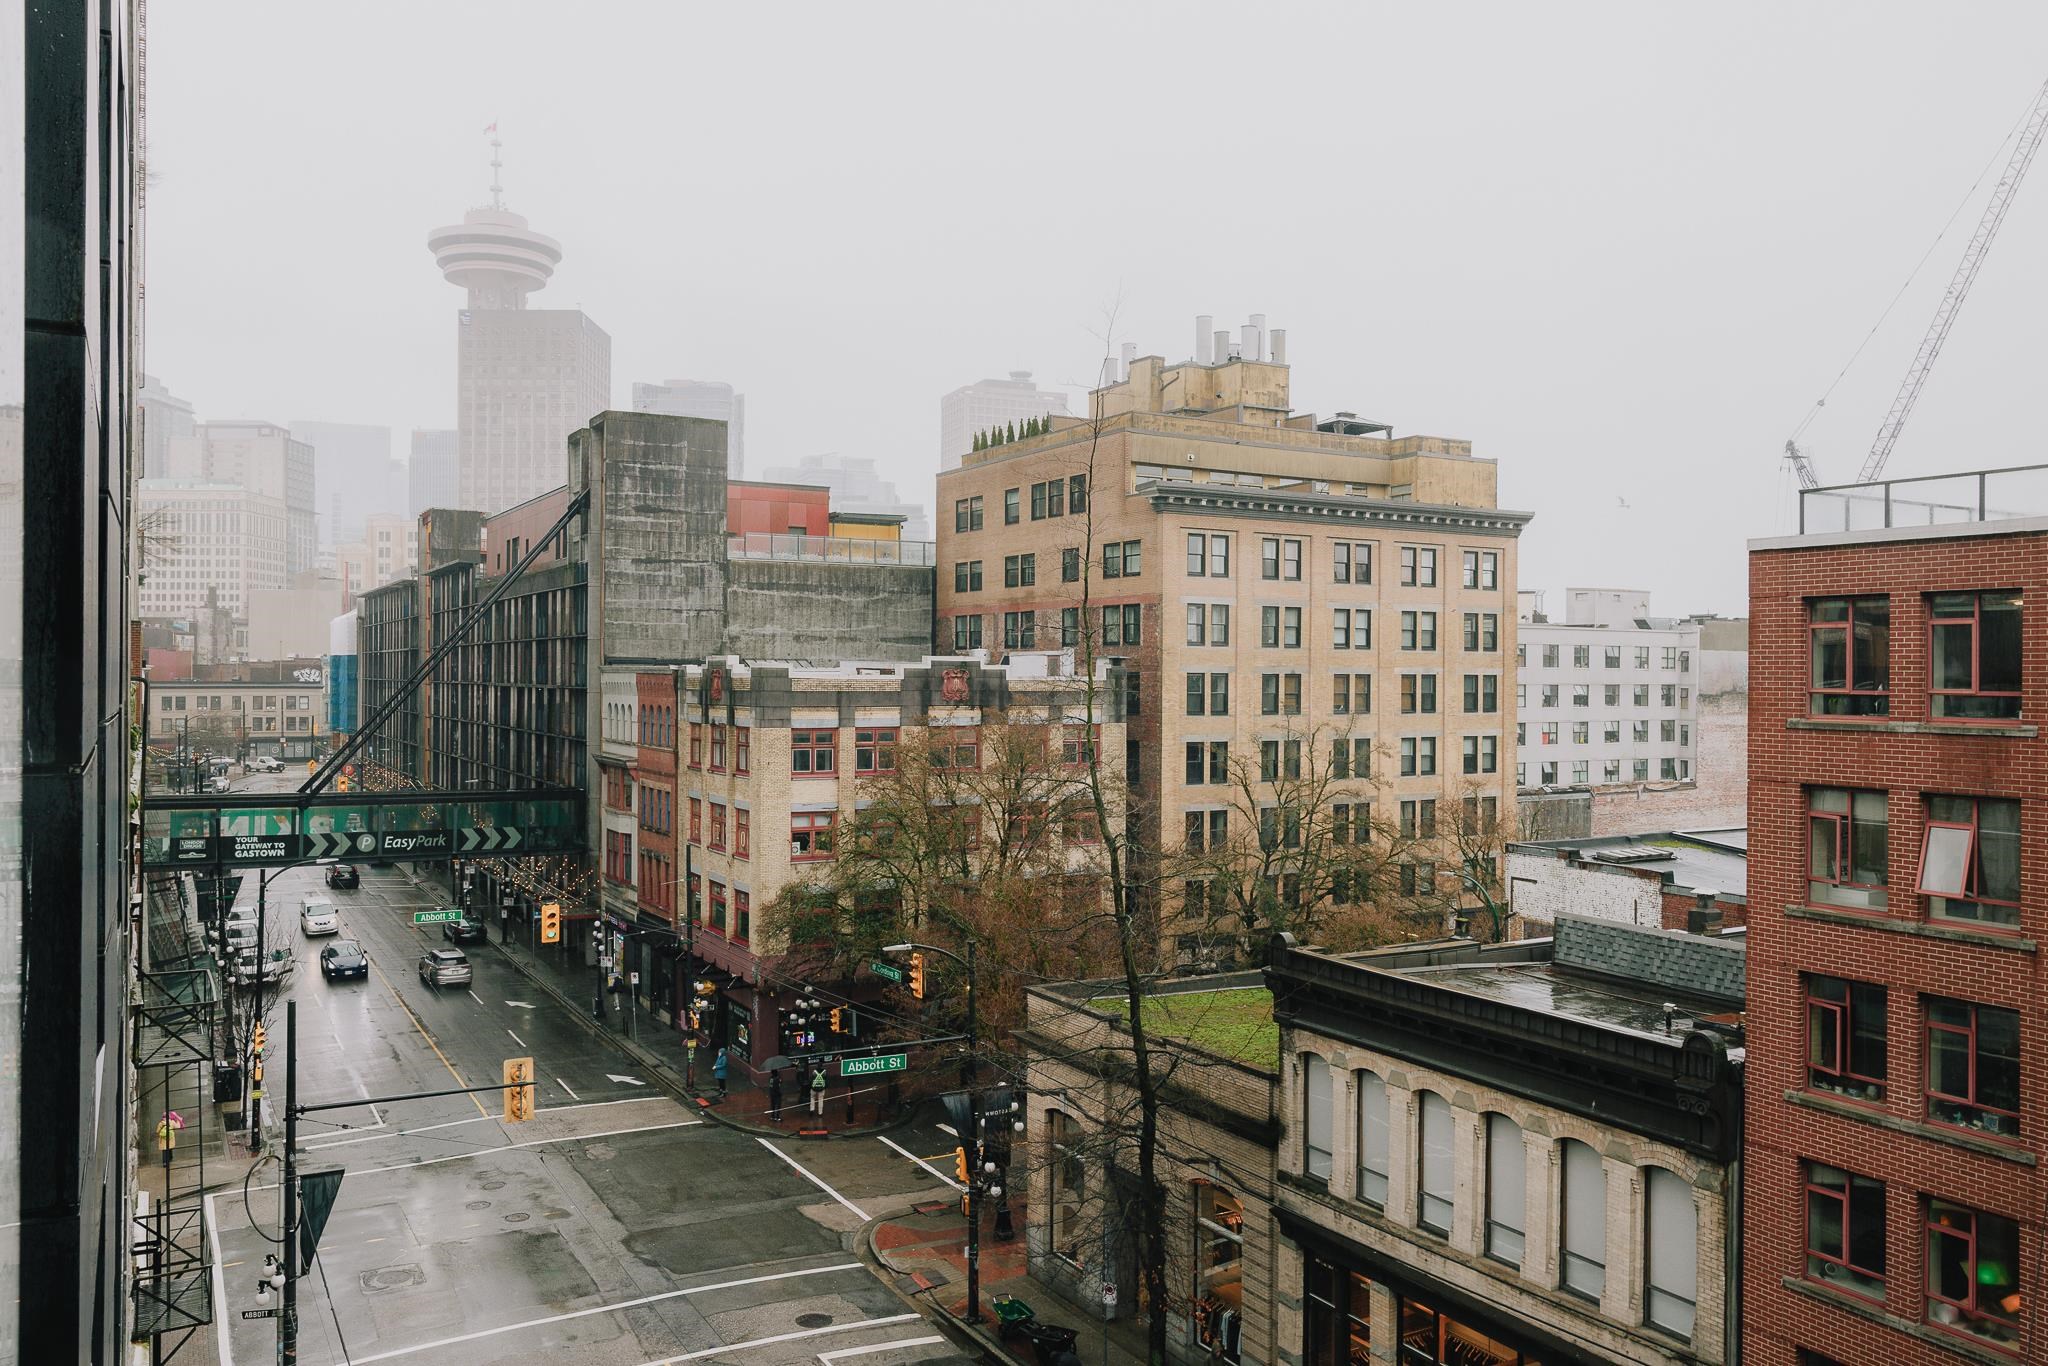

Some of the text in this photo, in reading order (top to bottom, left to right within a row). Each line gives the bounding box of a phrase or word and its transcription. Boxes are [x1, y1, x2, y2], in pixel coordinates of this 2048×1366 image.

[234, 842, 273, 850] GATEWAY
[384, 834, 447, 851] EasyPark
[234, 849, 285, 858] GASTOWN
[420, 912, 456, 922] Abbott St
[847, 1057, 901, 1073] Abbott St
[244, 1310, 269, 1319] ABBOTT
